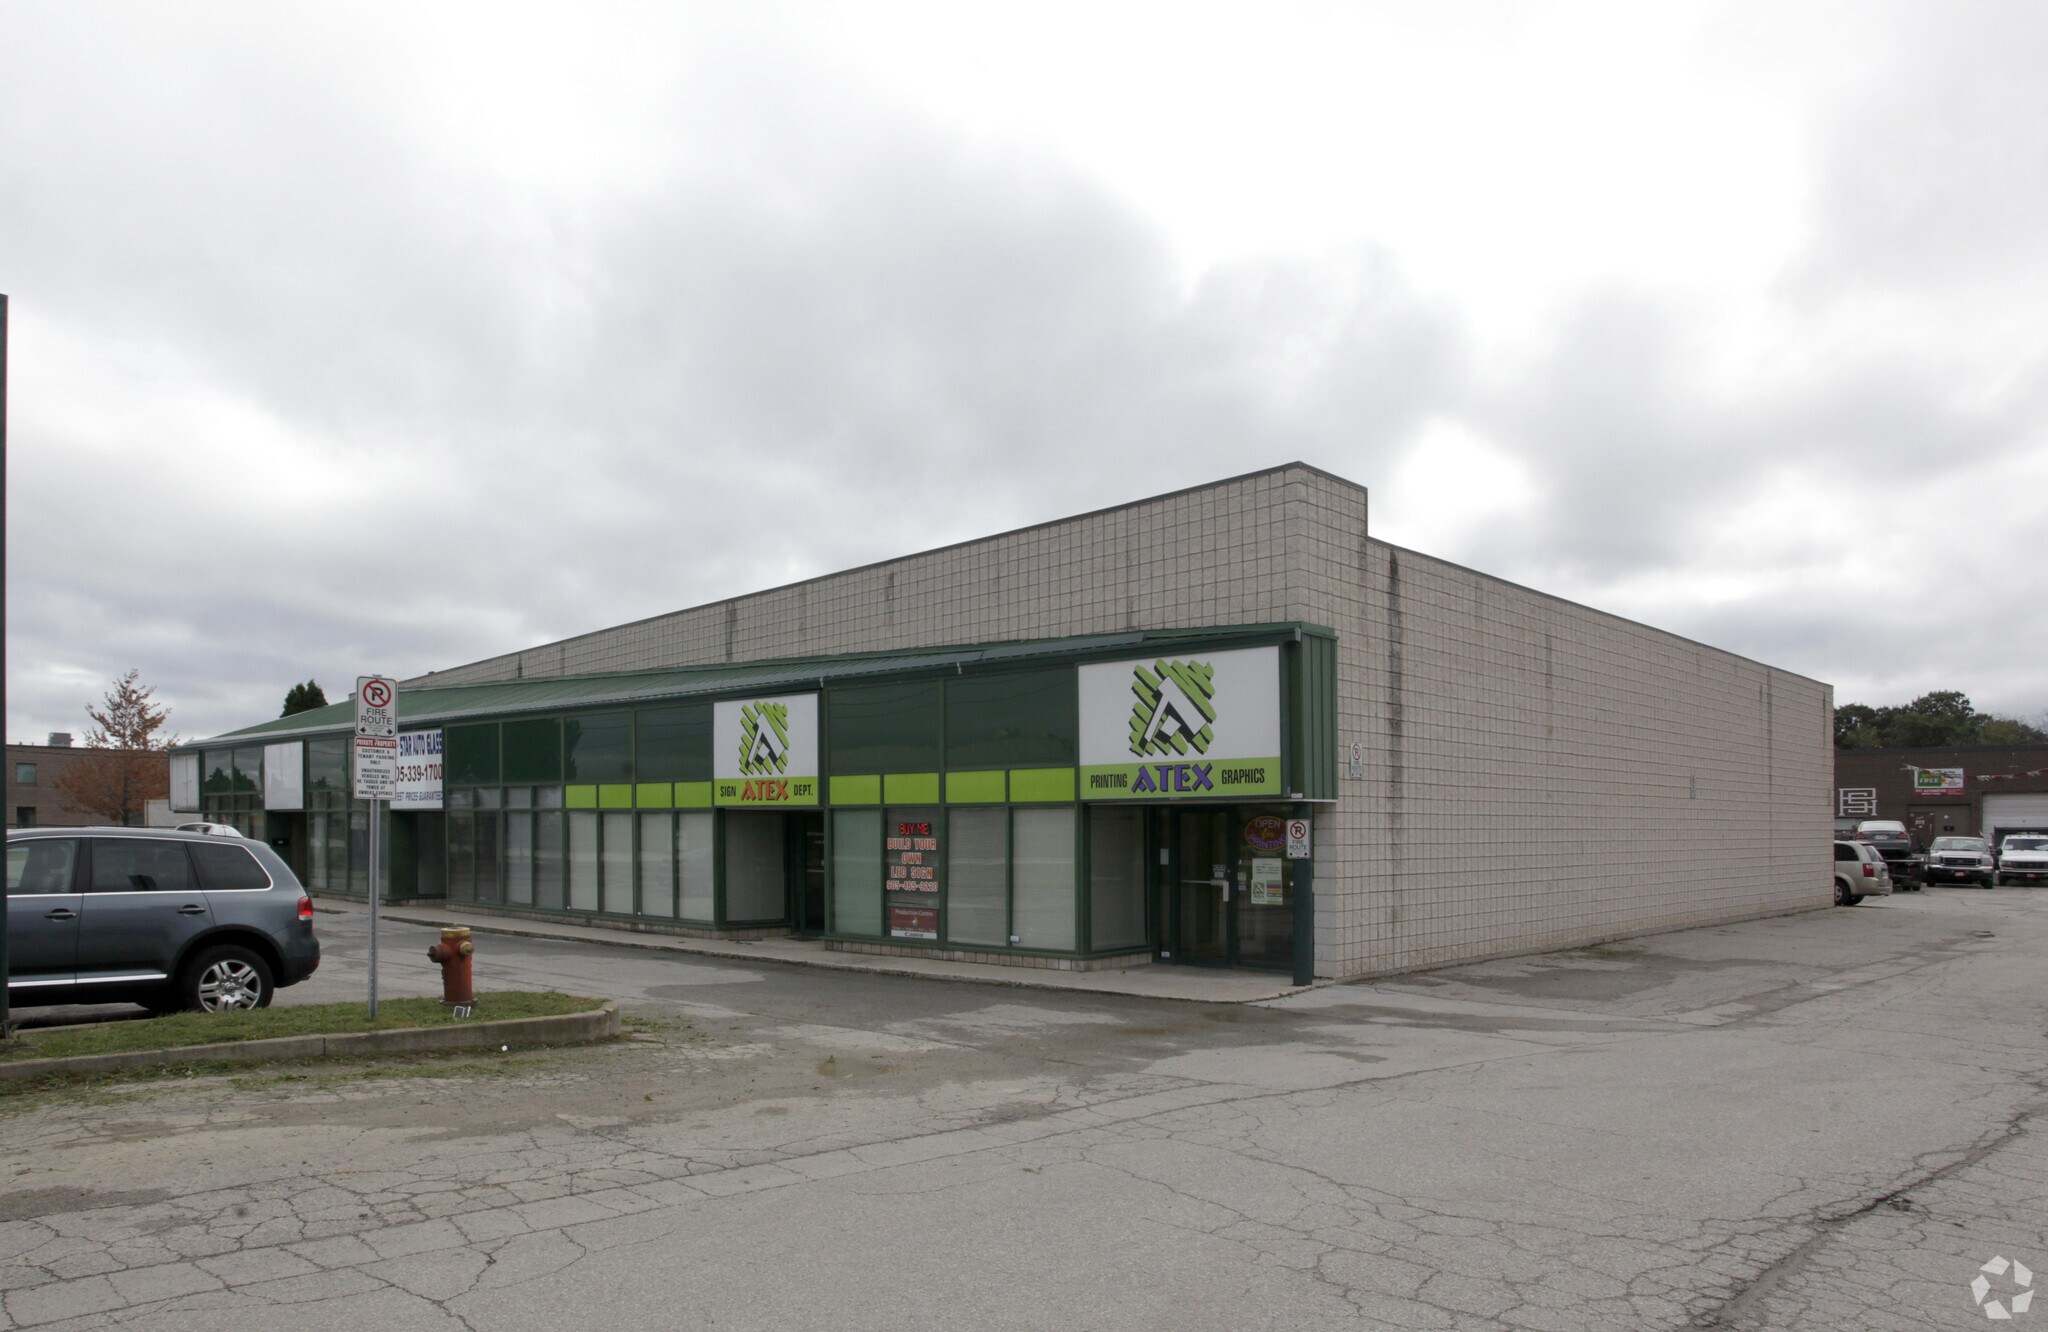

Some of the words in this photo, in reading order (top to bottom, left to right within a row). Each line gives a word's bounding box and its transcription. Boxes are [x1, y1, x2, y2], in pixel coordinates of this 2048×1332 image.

[366, 707, 387, 716] FIRE
[360, 715, 393, 725] ROUTE
[412, 734, 425, 756] AUTO
[426, 733, 443, 755] GLASS
[1090, 773, 1128, 789] PRINTING
[1131, 763, 1214, 793] ATEX
[1221, 768, 1265, 785] GRAPHICS
[720, 784, 737, 797] SIGN
[741, 779, 789, 801] ATEX
[793, 783, 814, 797] DEPT.
[899, 823, 914, 835] BUY
[917, 823, 929, 835] ME
[1254, 818, 1281, 828] OPEN
[887, 837, 911, 850] BUILD
[914, 838, 937, 851] YOUR
[902, 852, 922, 864] OWN
[891, 866, 907, 878] LED
[911, 866, 933, 879] SIGN
